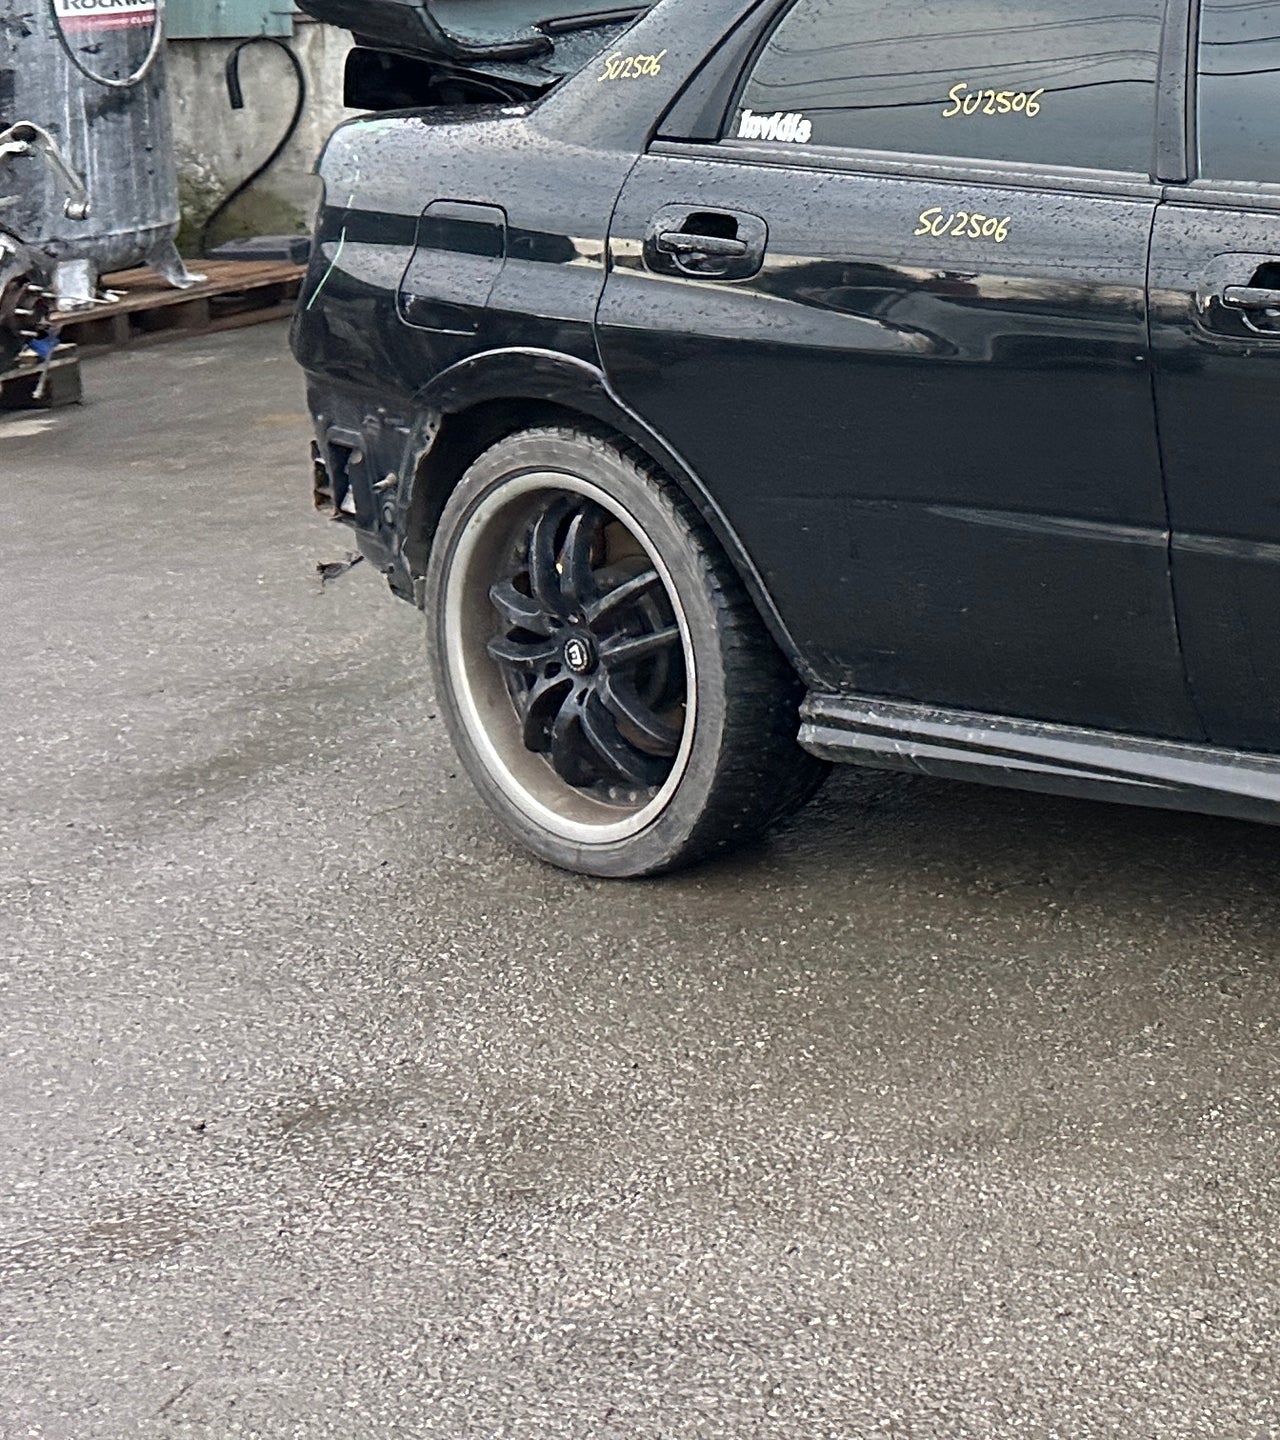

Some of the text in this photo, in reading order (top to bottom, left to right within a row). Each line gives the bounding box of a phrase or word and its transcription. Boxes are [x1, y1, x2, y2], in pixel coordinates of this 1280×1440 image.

[597, 49, 667, 81] SU2506
[942, 83, 1044, 118] SU2506
[914, 207, 1011, 243] SU2506
